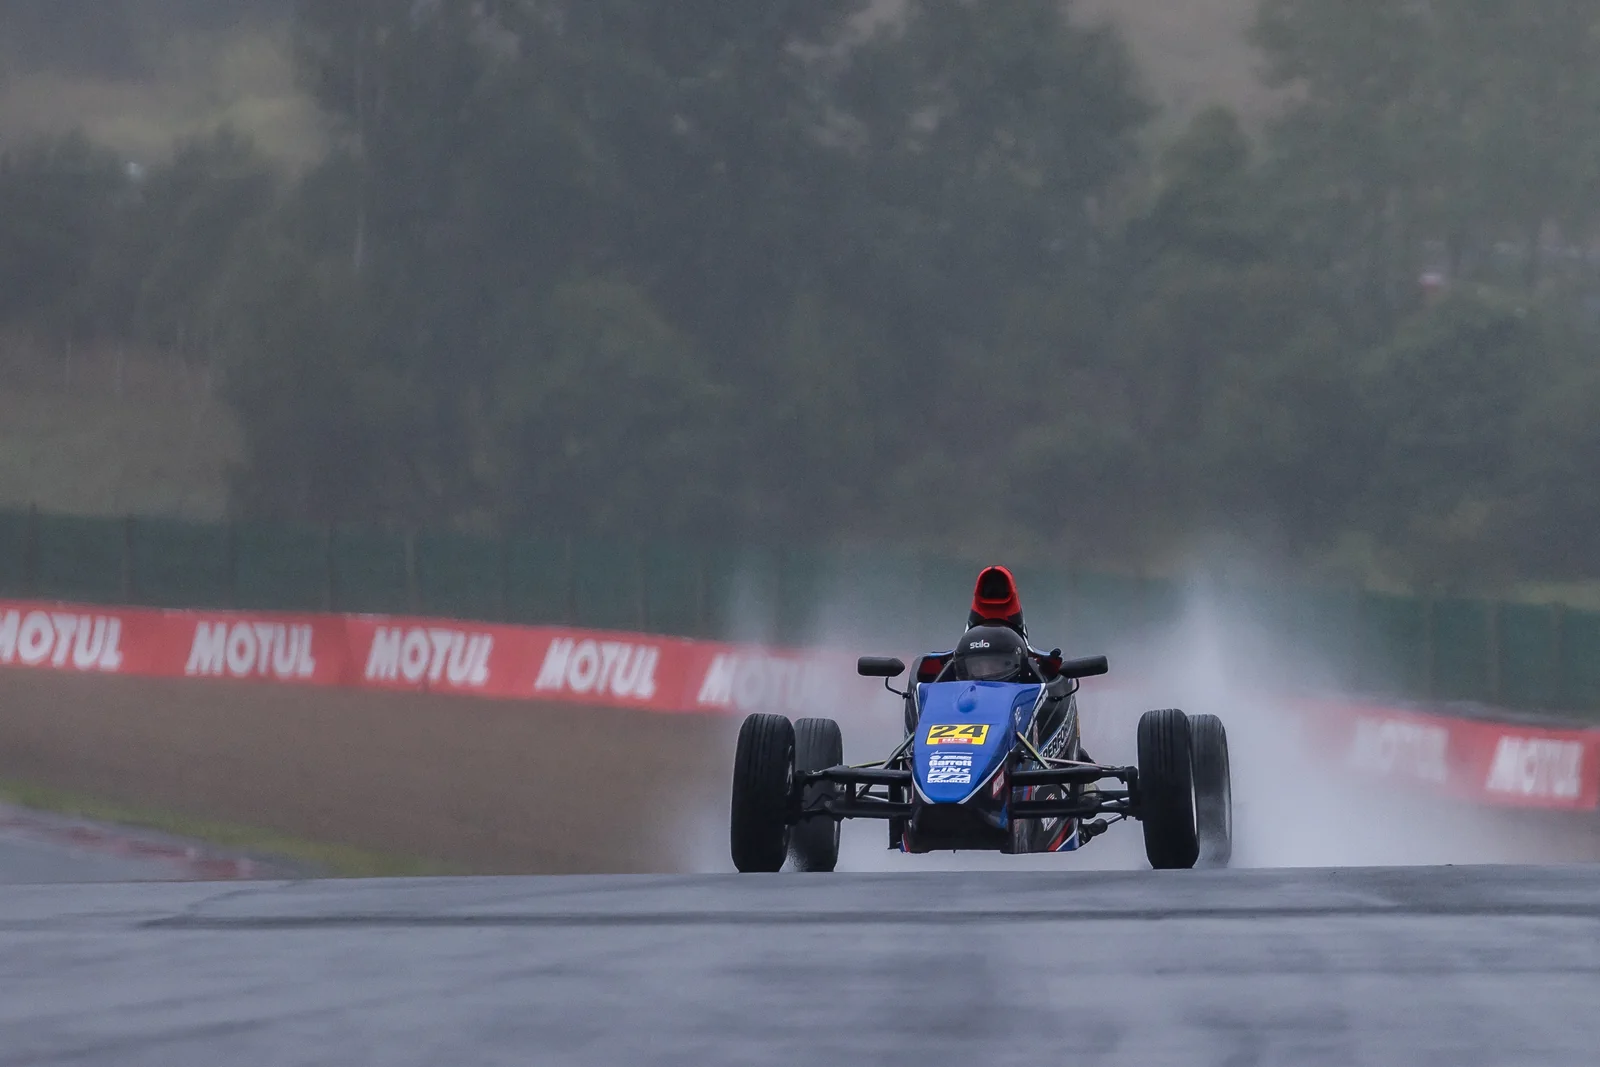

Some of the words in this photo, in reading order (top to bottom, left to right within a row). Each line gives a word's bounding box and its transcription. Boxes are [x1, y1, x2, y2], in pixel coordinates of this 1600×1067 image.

[185, 620, 315, 678] MOTUL
[365, 626, 494, 687] MOTUL
[535, 637, 660, 699] MOTUL
[929, 725, 984, 738] 24
